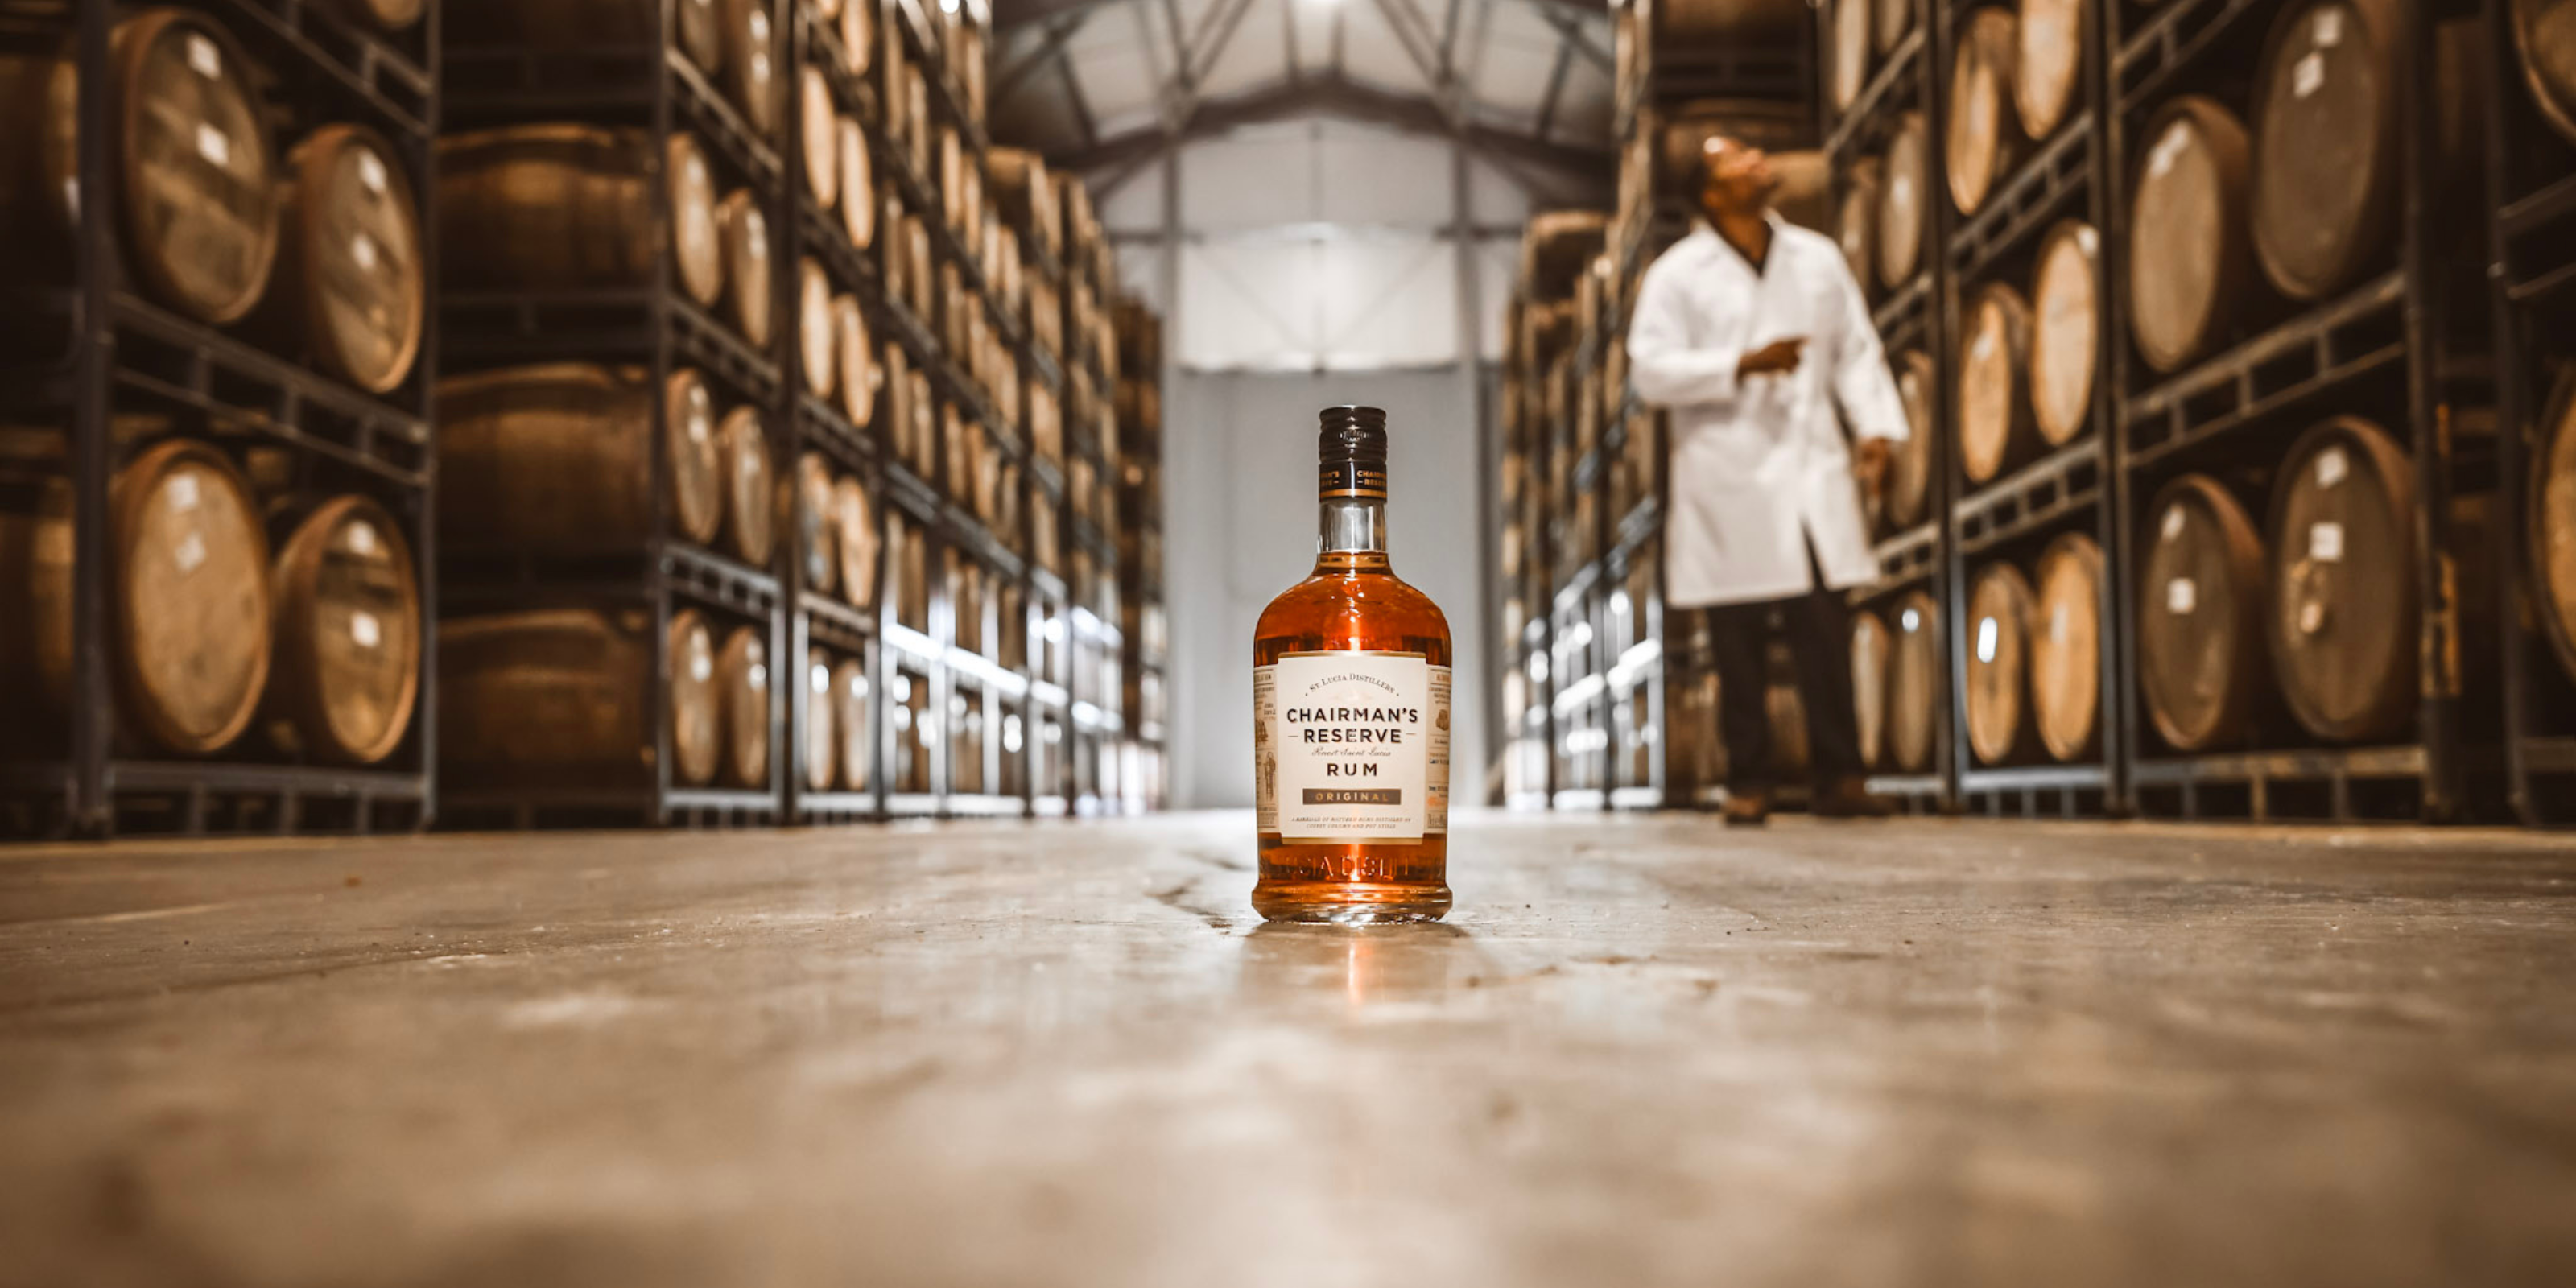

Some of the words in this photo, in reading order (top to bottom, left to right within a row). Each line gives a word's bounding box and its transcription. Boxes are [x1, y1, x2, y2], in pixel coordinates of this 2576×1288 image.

[1321, 674, 1348, 685] LUCIA
[1348, 672, 1395, 694] DISTILLERS
[1286, 707, 1418, 723] CHAIRMAN'S
[1303, 729, 1402, 743] RESERVE
[1327, 763, 1377, 776] RUM
[1315, 792, 1389, 802] ORIGINAL
